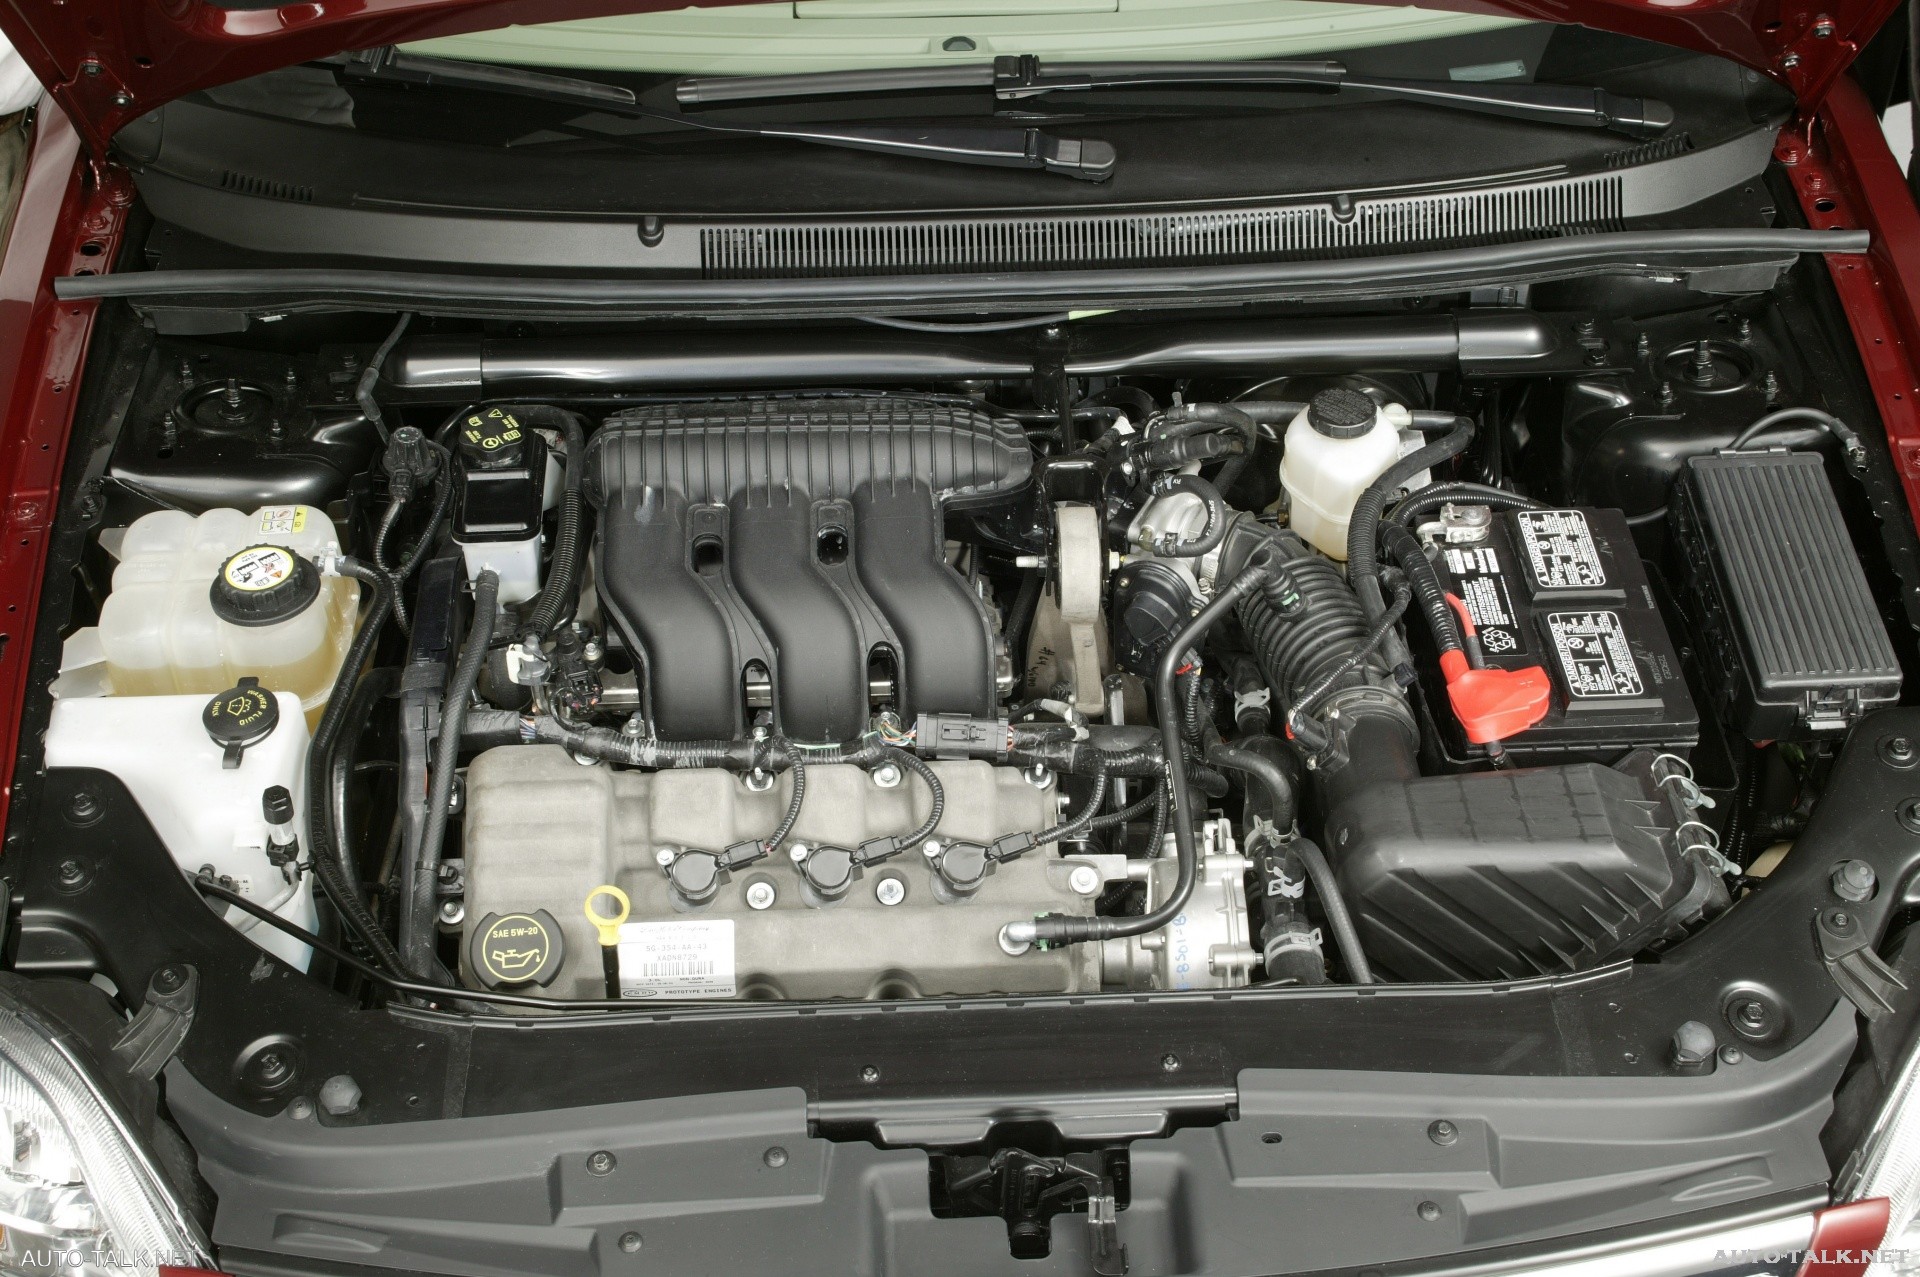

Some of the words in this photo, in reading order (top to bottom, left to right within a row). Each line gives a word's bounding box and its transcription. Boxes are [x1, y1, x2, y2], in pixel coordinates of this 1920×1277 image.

[1520, 517, 1546, 572] DANGER/POISON
[1471, 580, 1490, 624] AVERTISSEMENT
[1552, 623, 1578, 681] DANGER/POISON
[212, 701, 222, 716] ONLY
[247, 690, 267, 709] WASHER
[239, 711, 263, 726] FLUID
[492, 929, 509, 938] SAE
[510, 926, 538, 937] 5W-20
